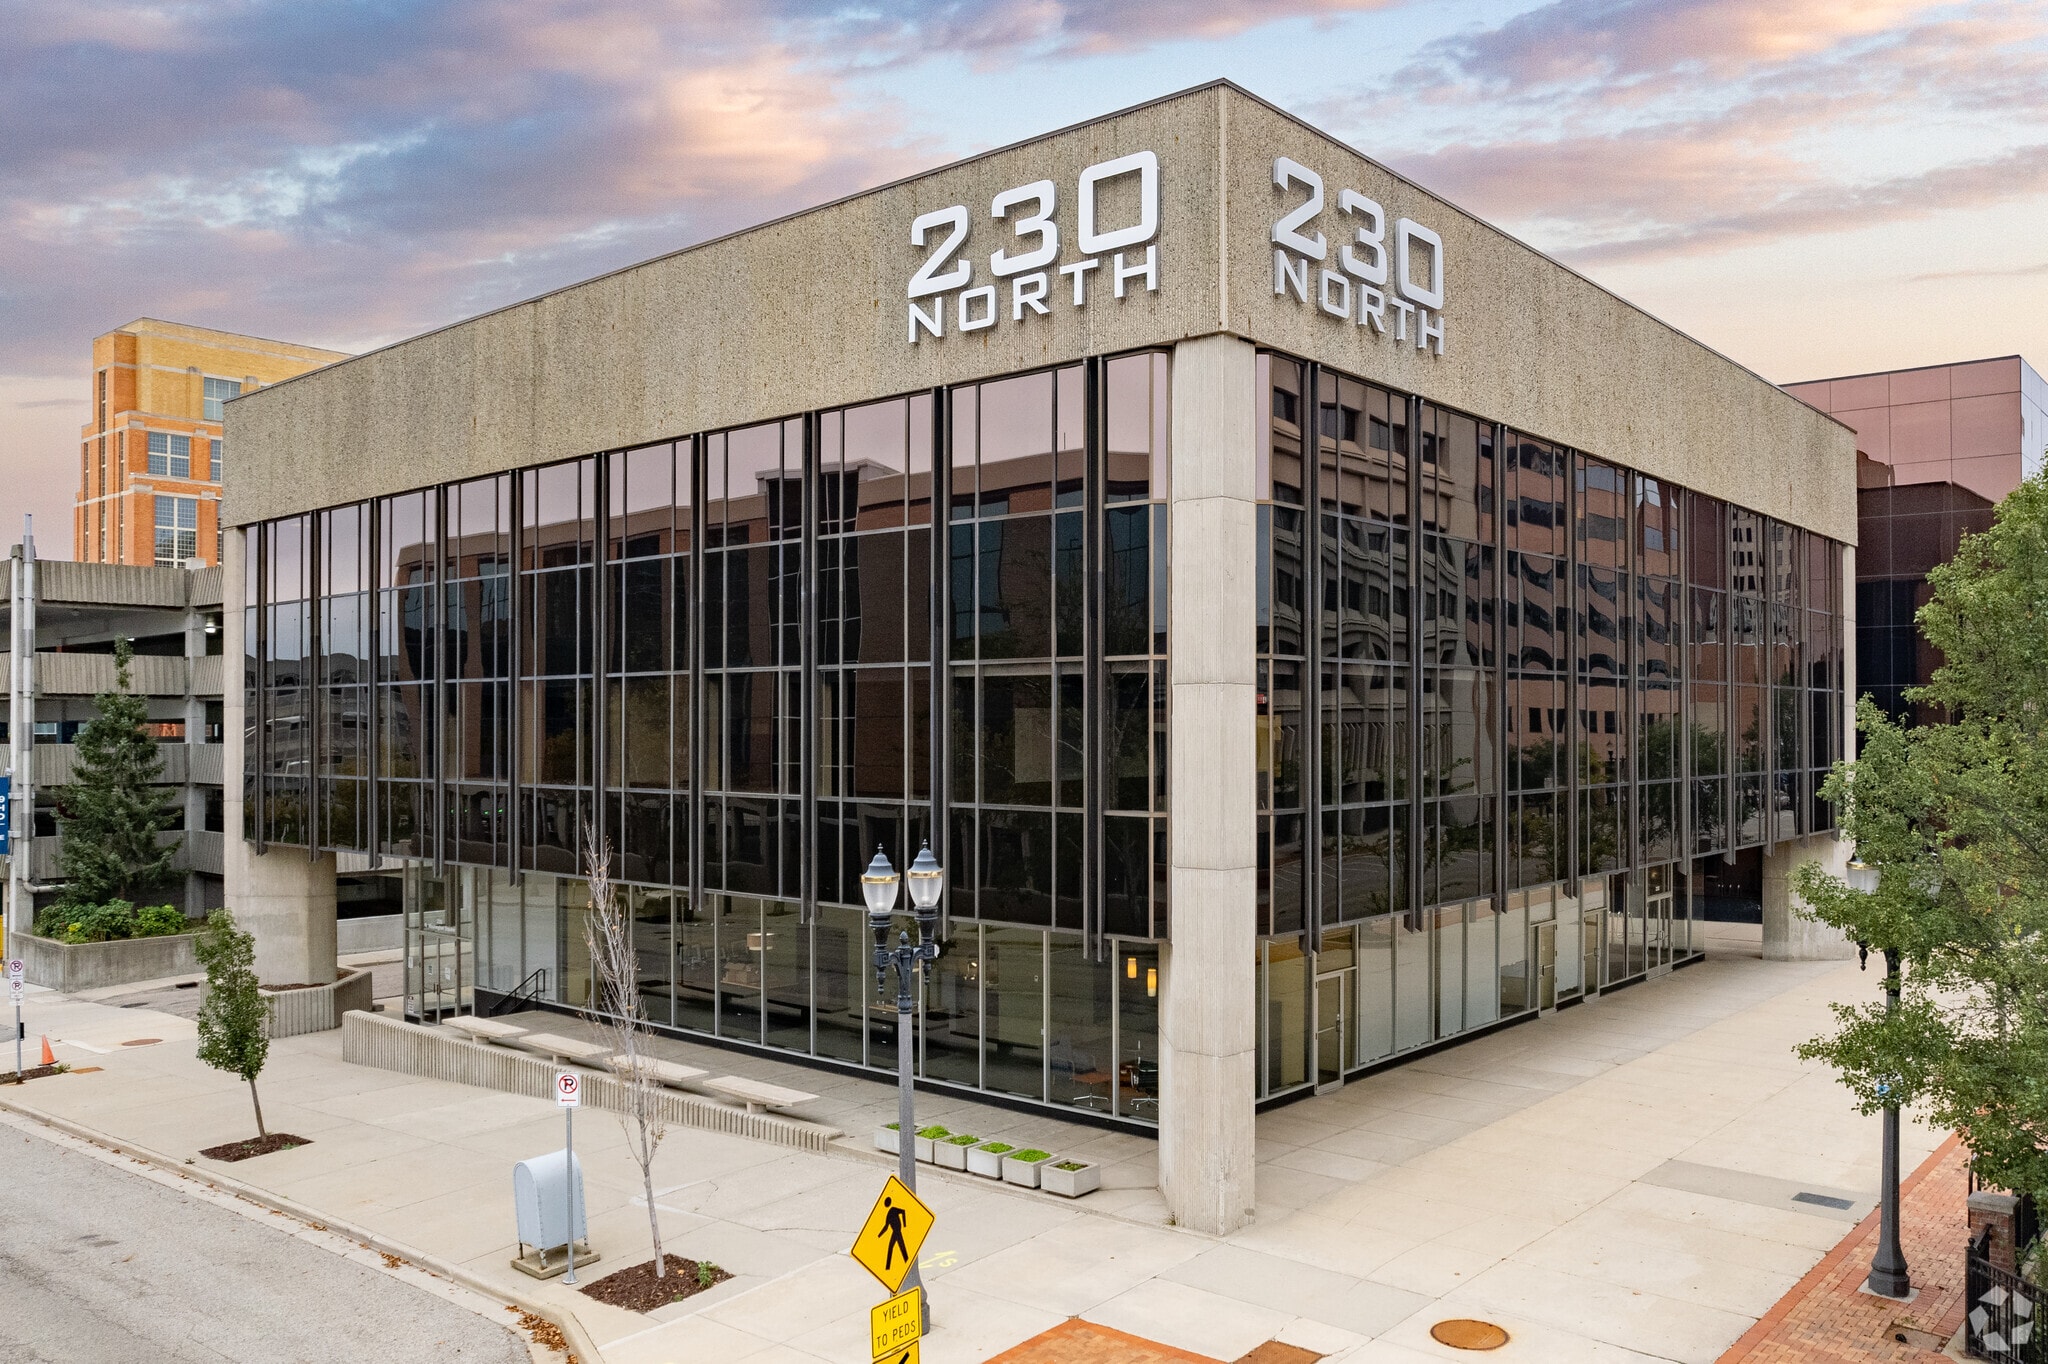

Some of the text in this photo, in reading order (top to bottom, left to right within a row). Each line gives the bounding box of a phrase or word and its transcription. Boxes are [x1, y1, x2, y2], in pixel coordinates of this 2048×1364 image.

[907, 150, 1161, 299] 230
[1272, 157, 1444, 310] 230
[908, 245, 1159, 343] NORTH
[1273, 249, 1445, 356] NORTH
[876, 1320, 916, 1348] TO PEDS
[883, 1301, 909, 1322] YIELD
